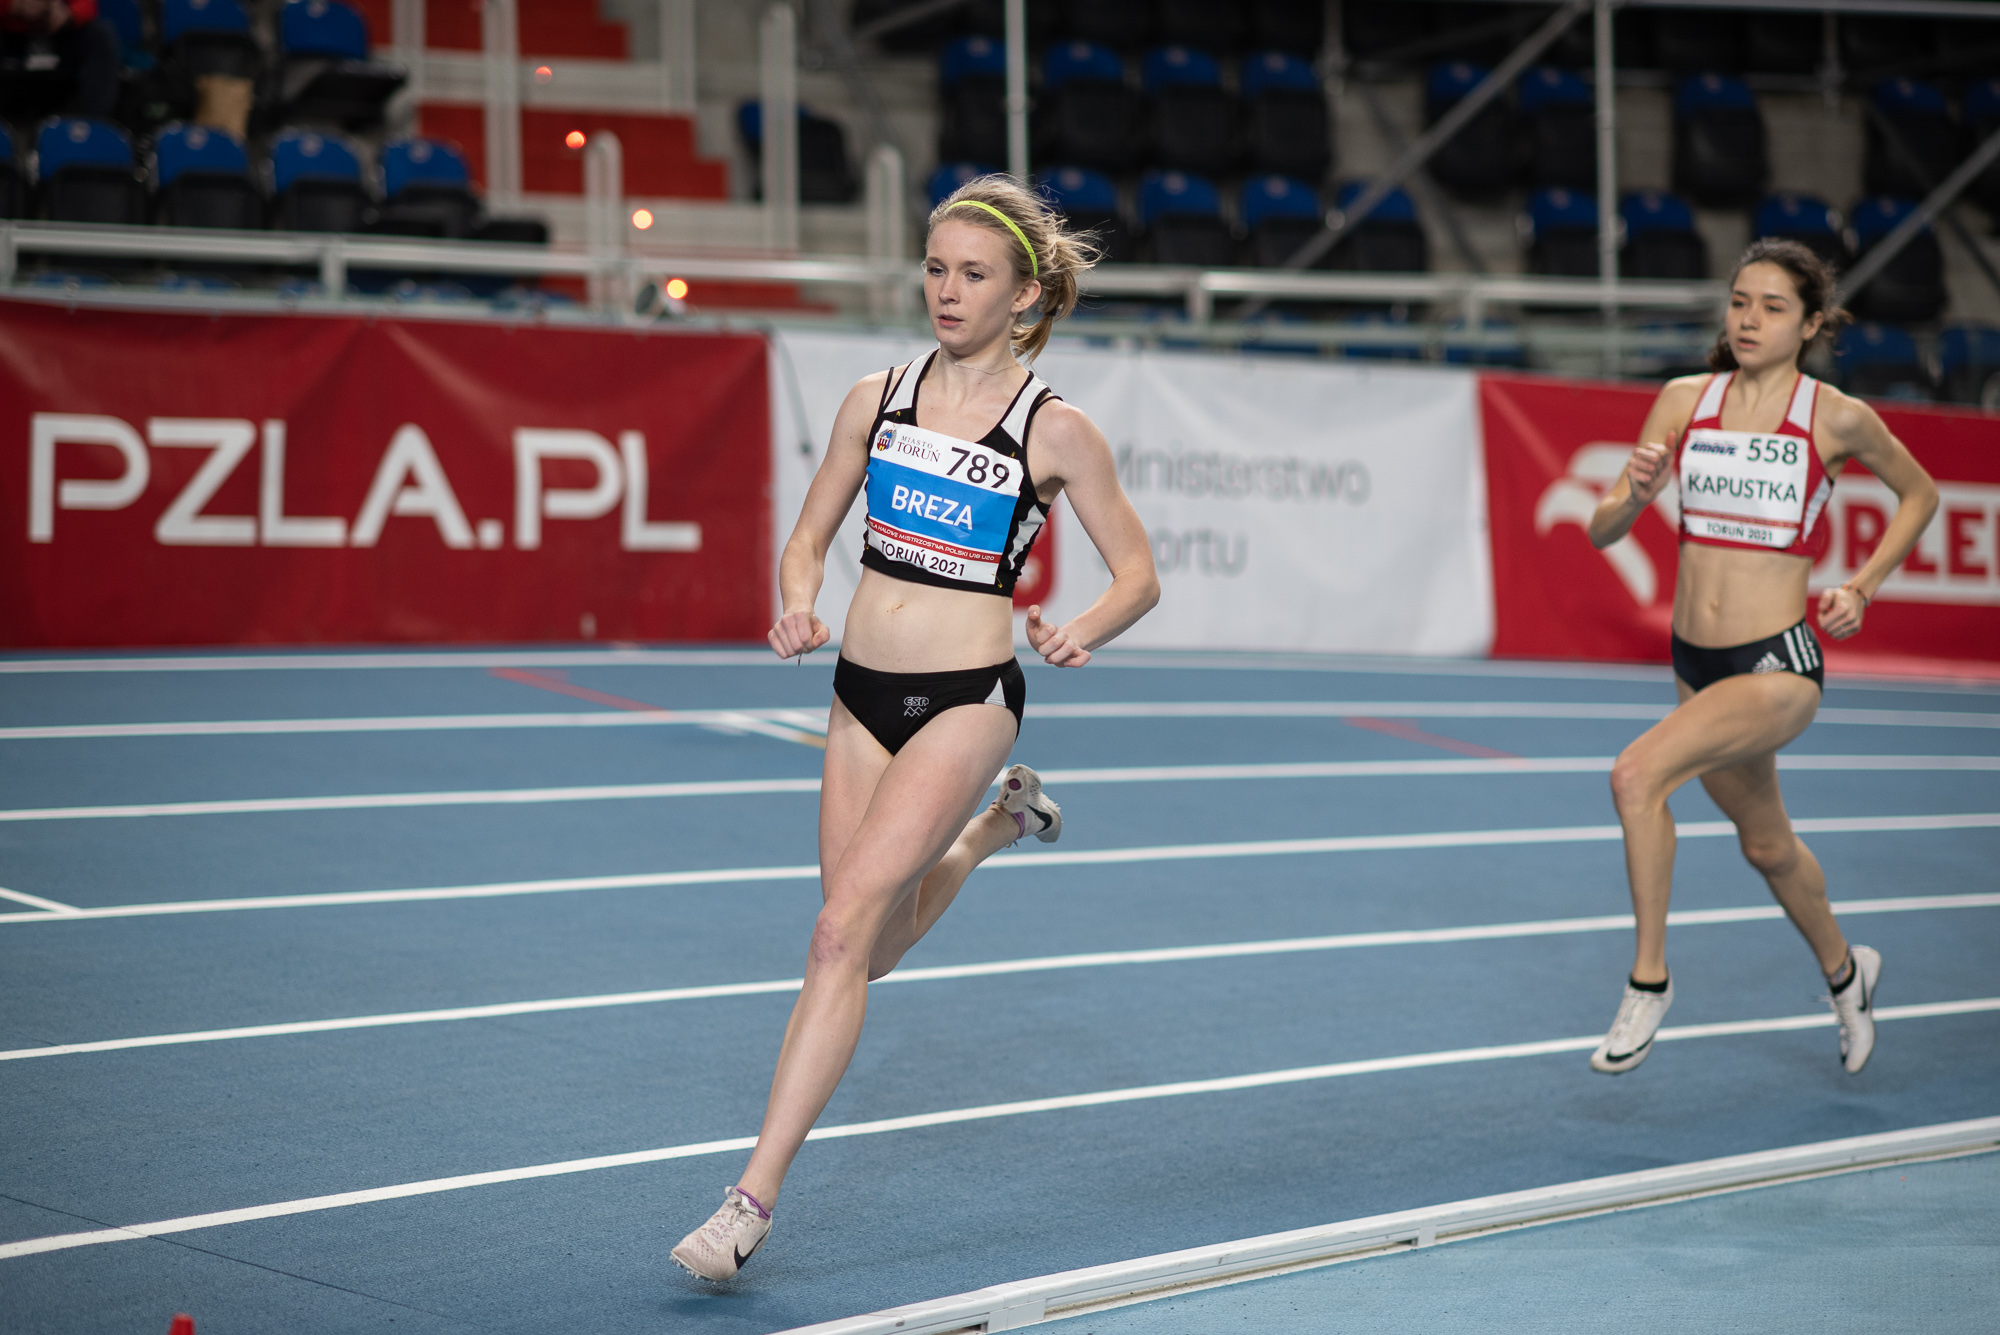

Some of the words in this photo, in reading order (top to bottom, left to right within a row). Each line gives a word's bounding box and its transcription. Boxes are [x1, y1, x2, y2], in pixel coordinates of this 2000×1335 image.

[897, 441, 941, 463] TORUŃ
[901, 435, 933, 449] MIASTO
[1746, 438, 1798, 465] 558
[28, 412, 702, 552] PZLA.PL
[946, 446, 1010, 488] 789
[1688, 473, 1798, 503] KAPUSTKA
[891, 484, 973, 530] BREZA
[877, 525, 899, 538] HALOWE
[899, 533, 945, 550] MISTRZOSTWA
[945, 546, 969, 557] POLSKI
[1706, 522, 1744, 538] TORUŃ
[1748, 527, 1773, 541] 2021
[881, 540, 926, 566] TORUŃ
[929, 556, 965, 576] 2021
